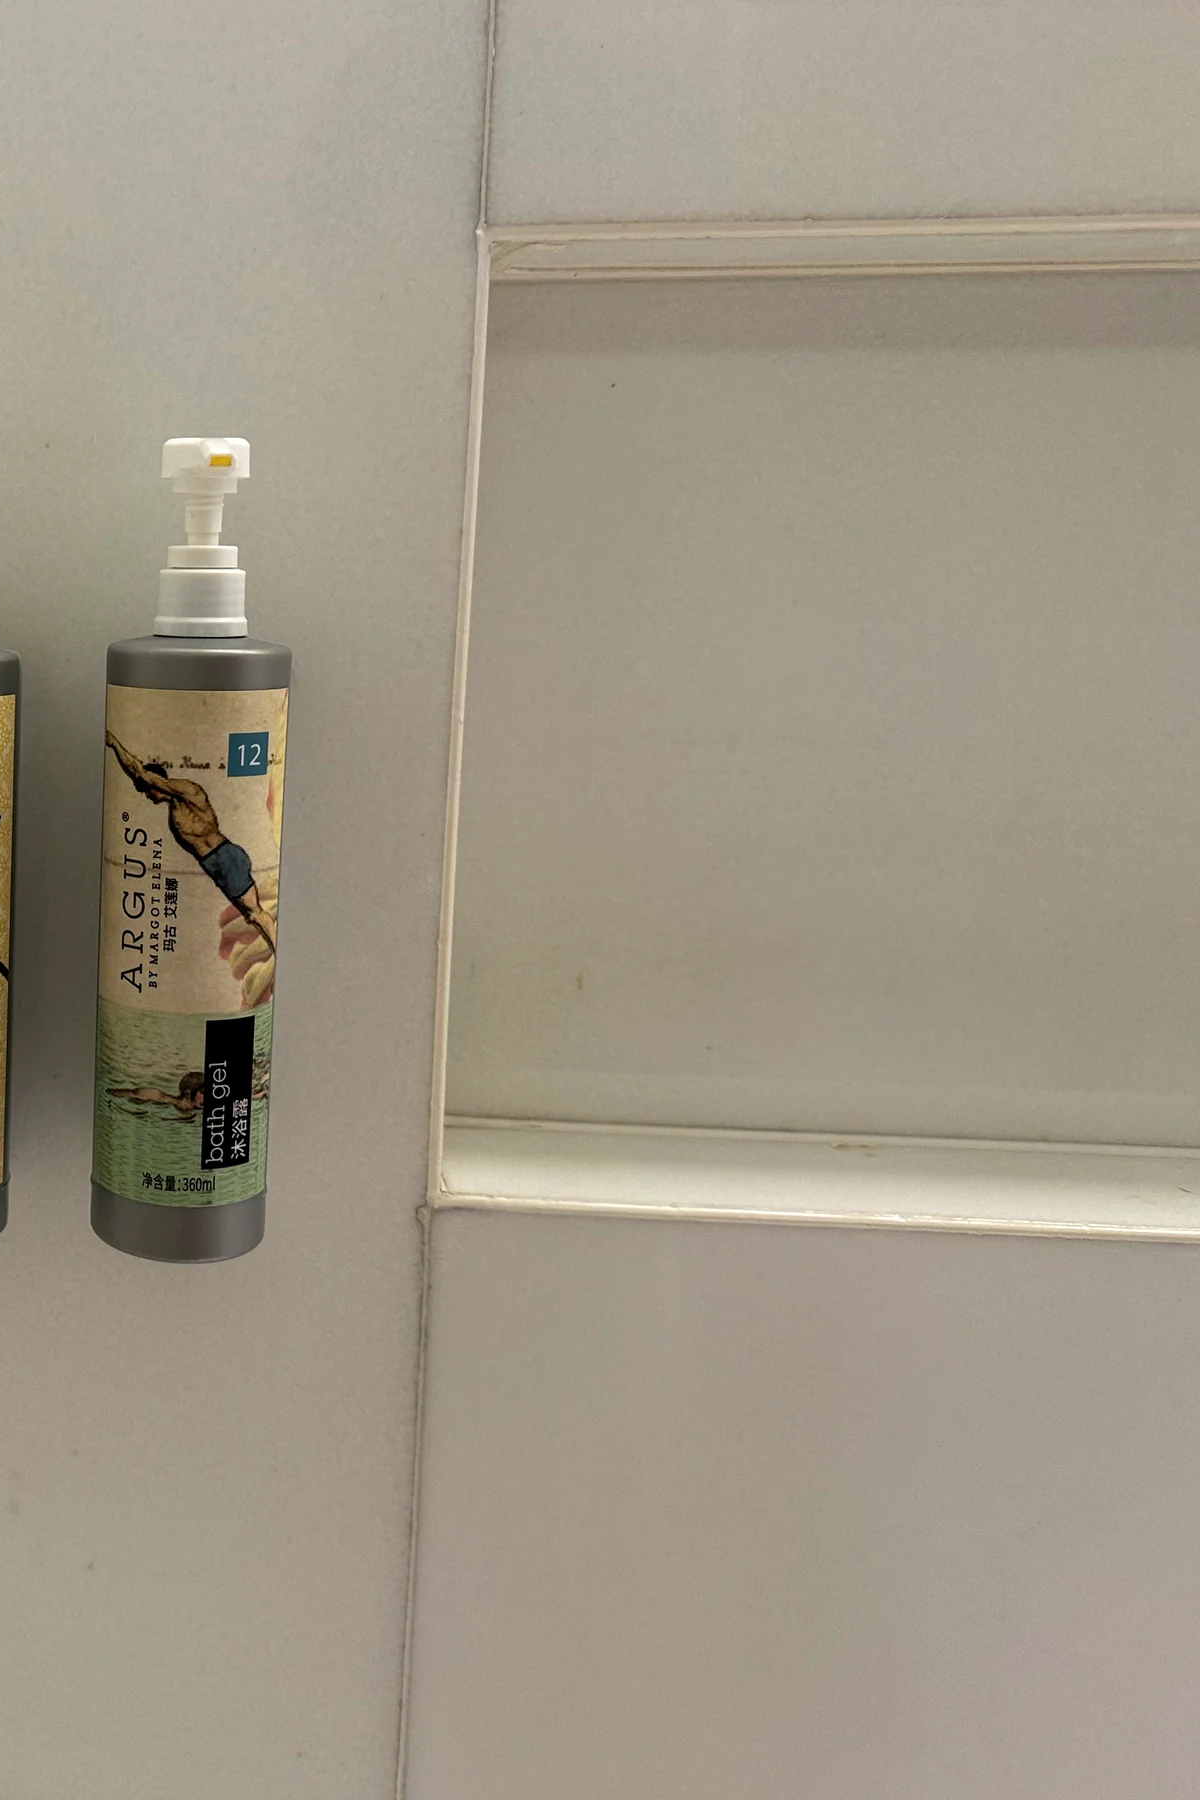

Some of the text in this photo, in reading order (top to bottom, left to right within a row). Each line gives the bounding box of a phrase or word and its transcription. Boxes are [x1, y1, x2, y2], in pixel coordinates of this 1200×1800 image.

[237, 743, 261, 767] 12
[148, 837, 163, 989] BY MARGOT ELENA
[162, 877, 179, 953] 玛古 艾莲娜
[205, 1060, 231, 1164] bath gel
[230, 1097, 249, 1160] 沐浴露
